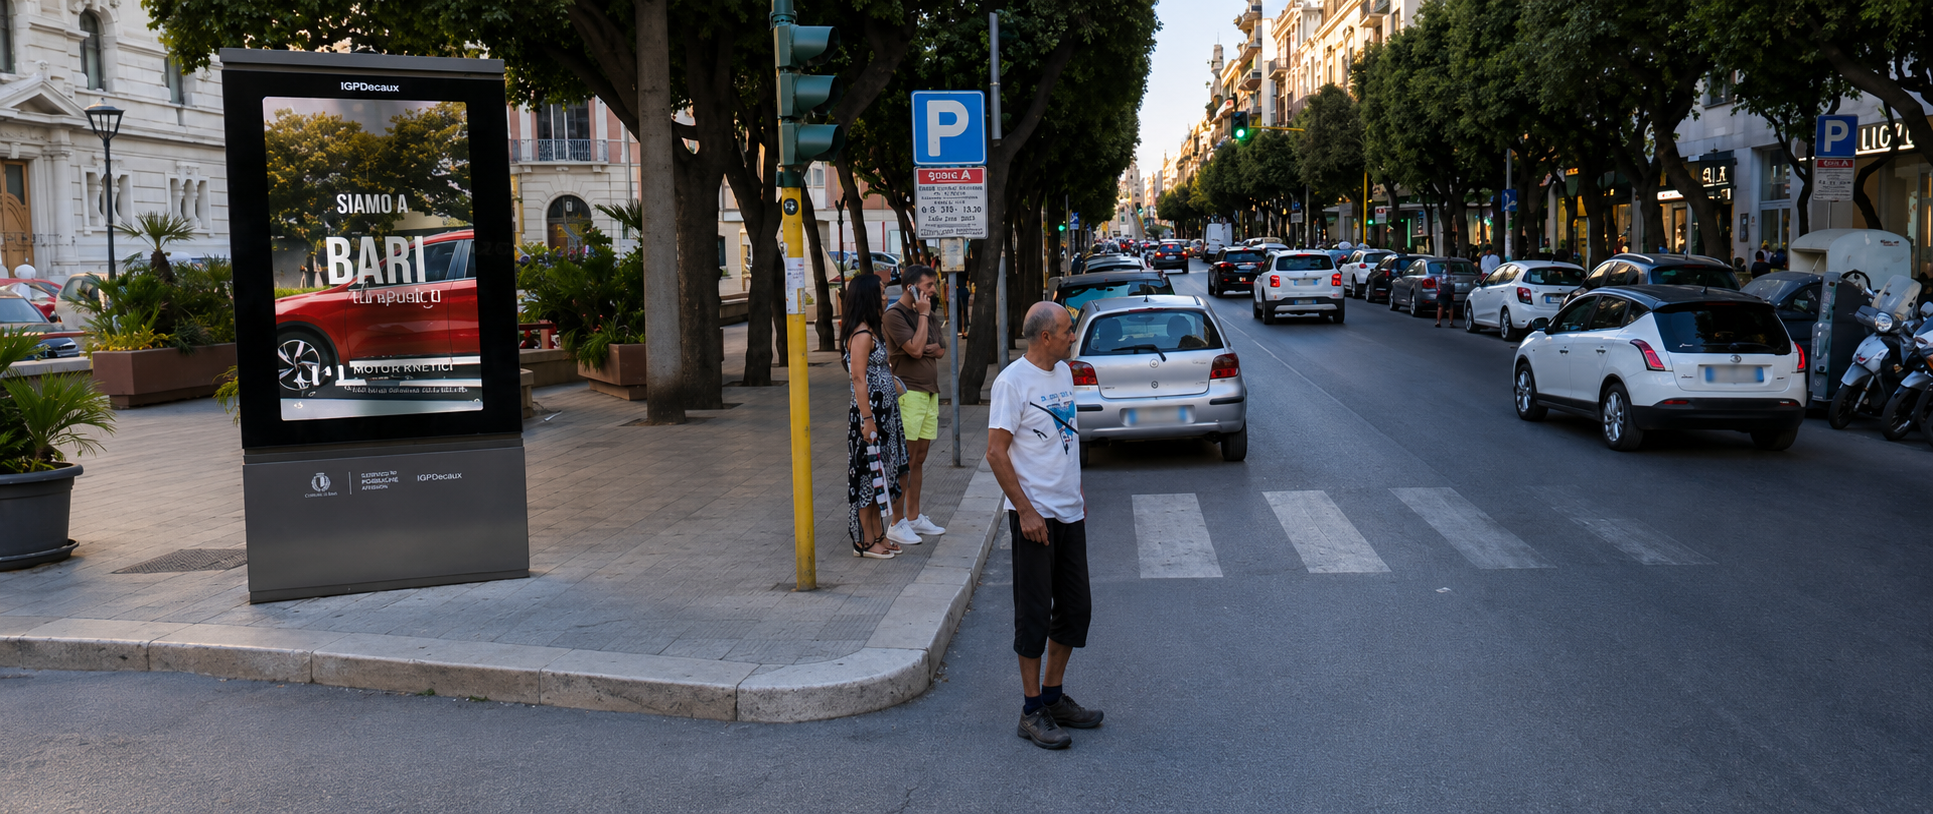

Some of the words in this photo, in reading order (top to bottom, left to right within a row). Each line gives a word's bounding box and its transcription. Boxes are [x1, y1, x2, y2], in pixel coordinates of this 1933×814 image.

[340, 81, 399, 93] IGPDecaux
[927, 100, 969, 157] P
[1824, 120, 1849, 152] P
[960, 169, 971, 180] A
[336, 193, 392, 214] SIAMO
[397, 194, 409, 214] A
[325, 235, 426, 285] BARI
[353, 365, 400, 375] MOTOR
[417, 473, 462, 482] IGPDecaux
